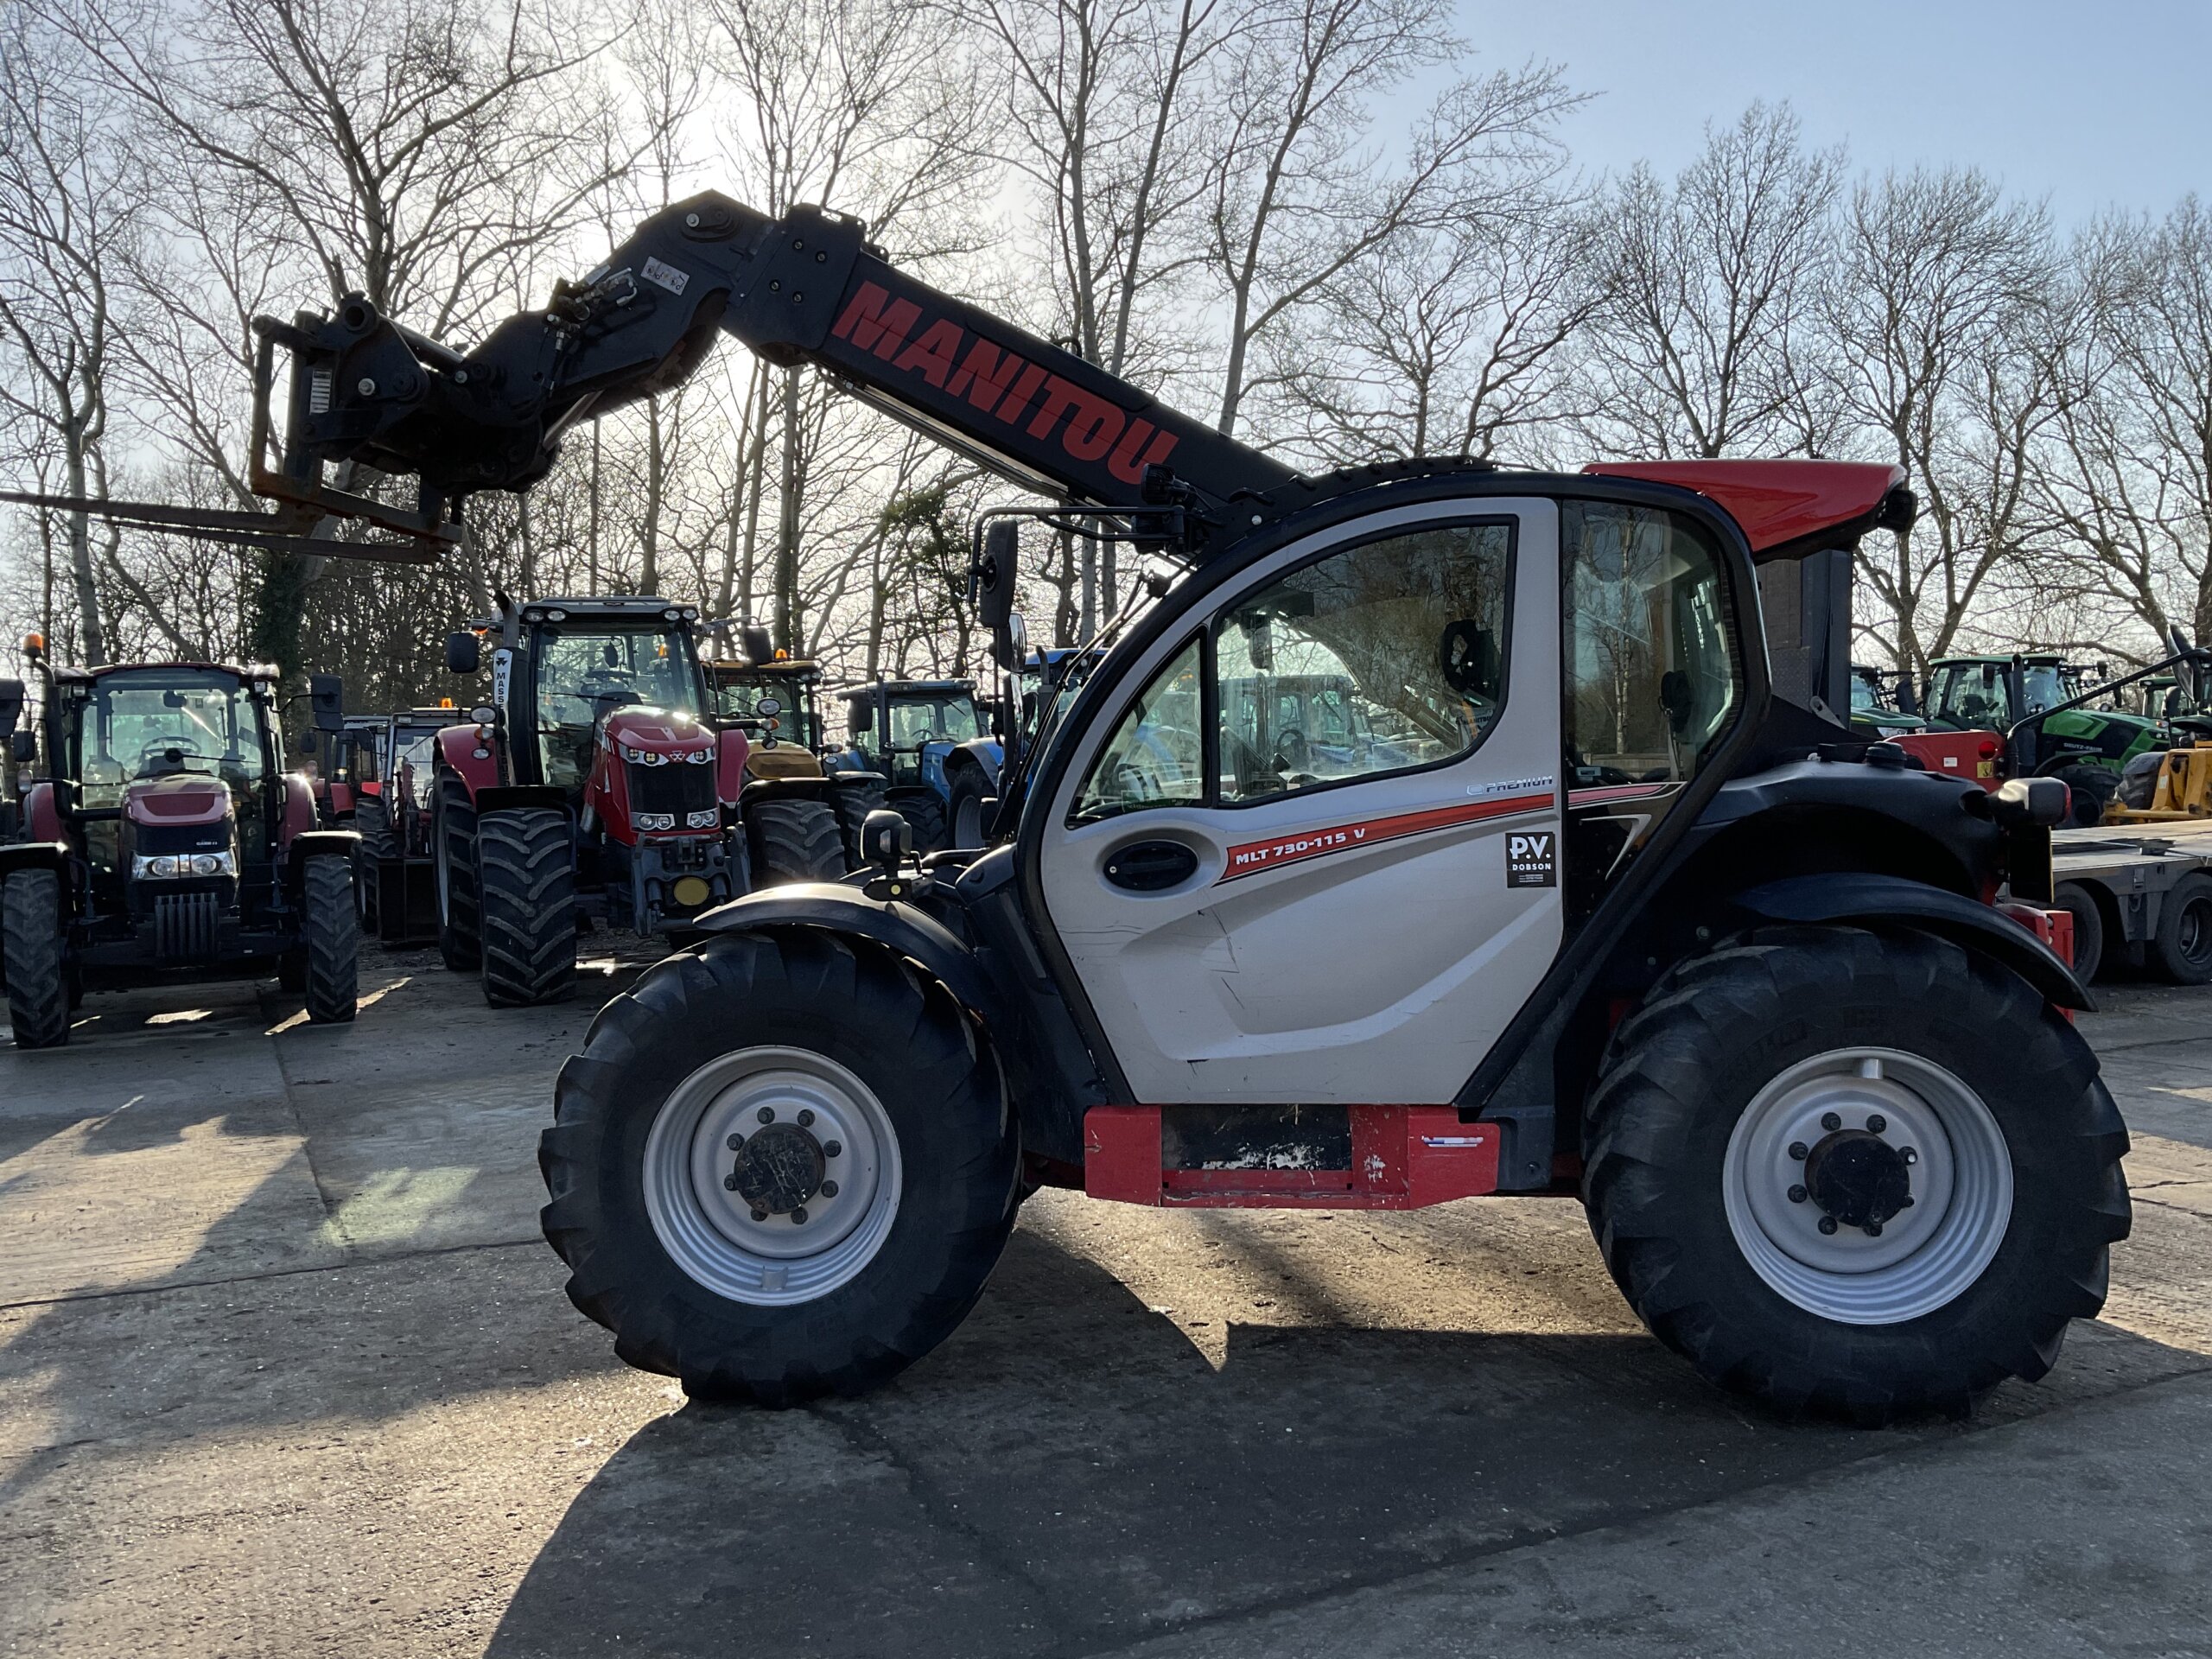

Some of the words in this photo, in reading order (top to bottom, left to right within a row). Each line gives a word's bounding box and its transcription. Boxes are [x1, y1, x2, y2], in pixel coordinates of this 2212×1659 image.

[831, 280, 1179, 485] MANITOU
[1486, 775, 1553, 792] PREMIUM
[1236, 849, 1269, 865] MLT
[1273, 832, 1346, 856] 730-115
[1354, 828, 1365, 839] V
[1509, 836, 1551, 860] P.V.
